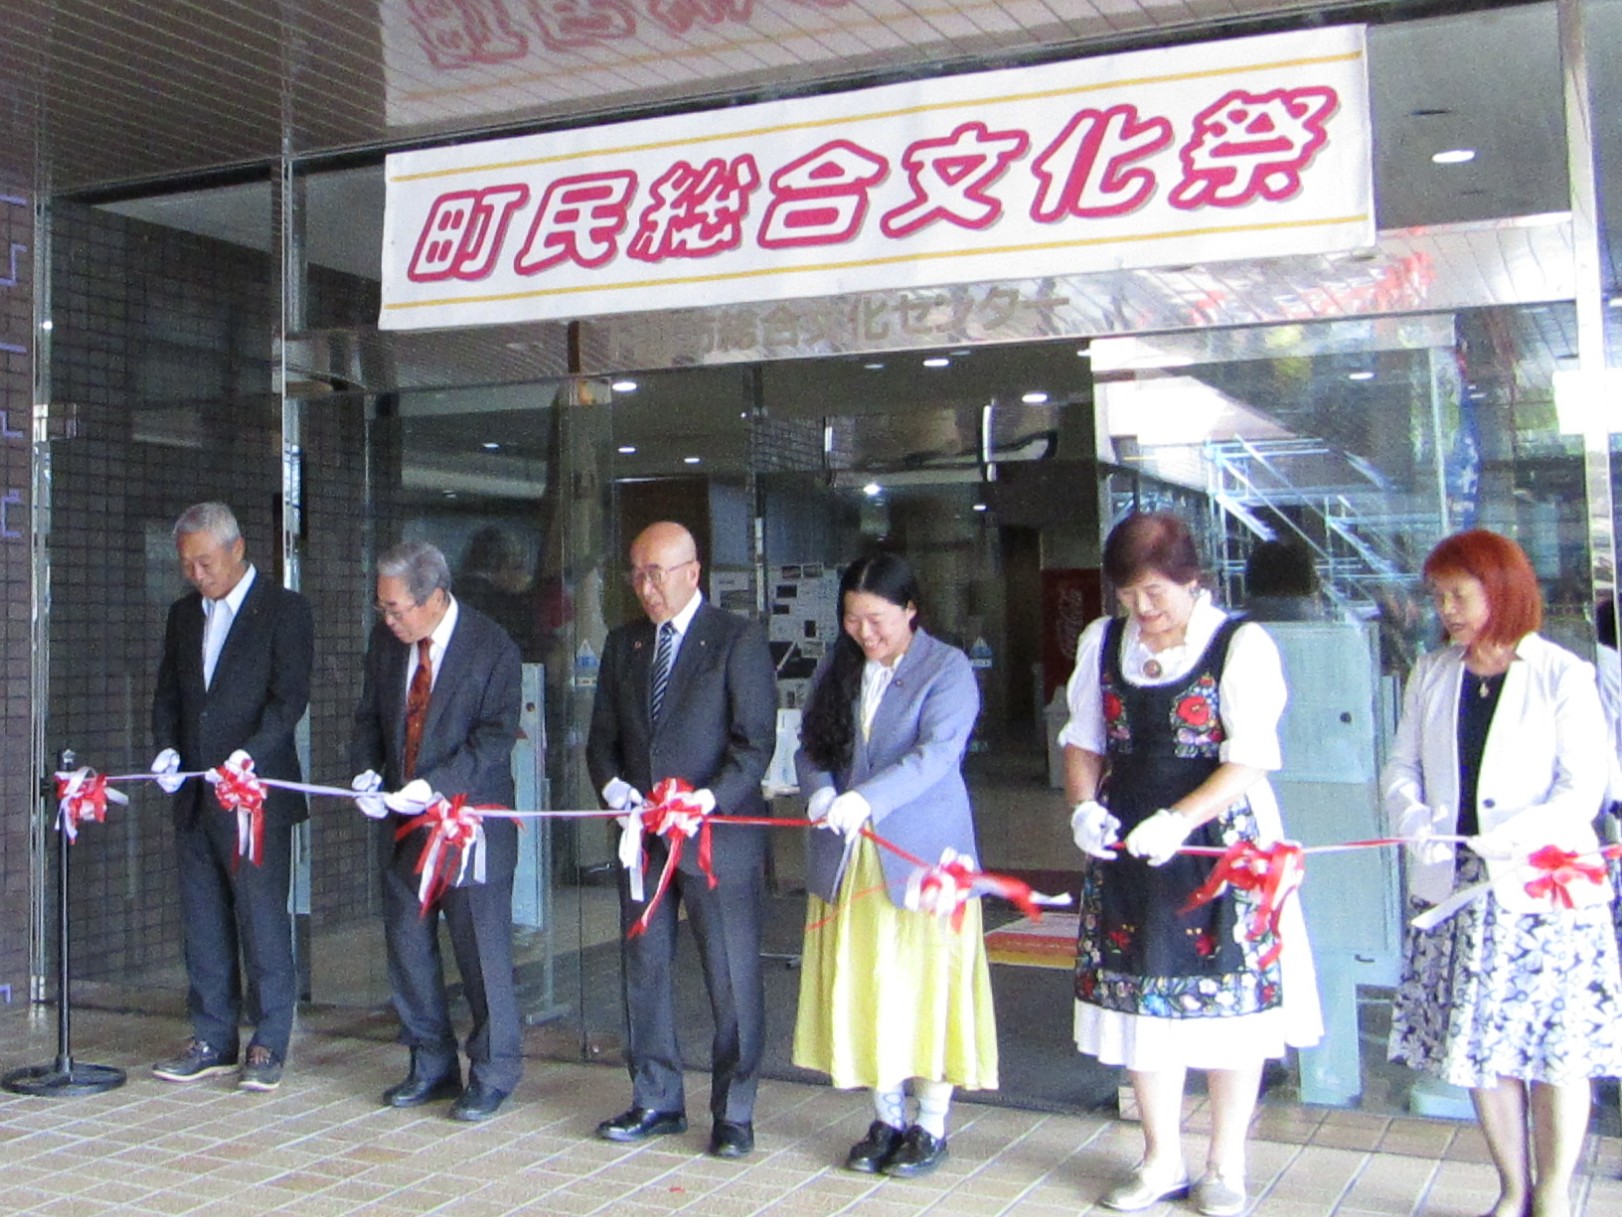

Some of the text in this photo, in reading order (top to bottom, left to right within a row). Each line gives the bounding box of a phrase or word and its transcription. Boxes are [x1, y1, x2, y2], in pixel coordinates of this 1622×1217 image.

[407, 87, 1339, 284] 町民総合文化祭
